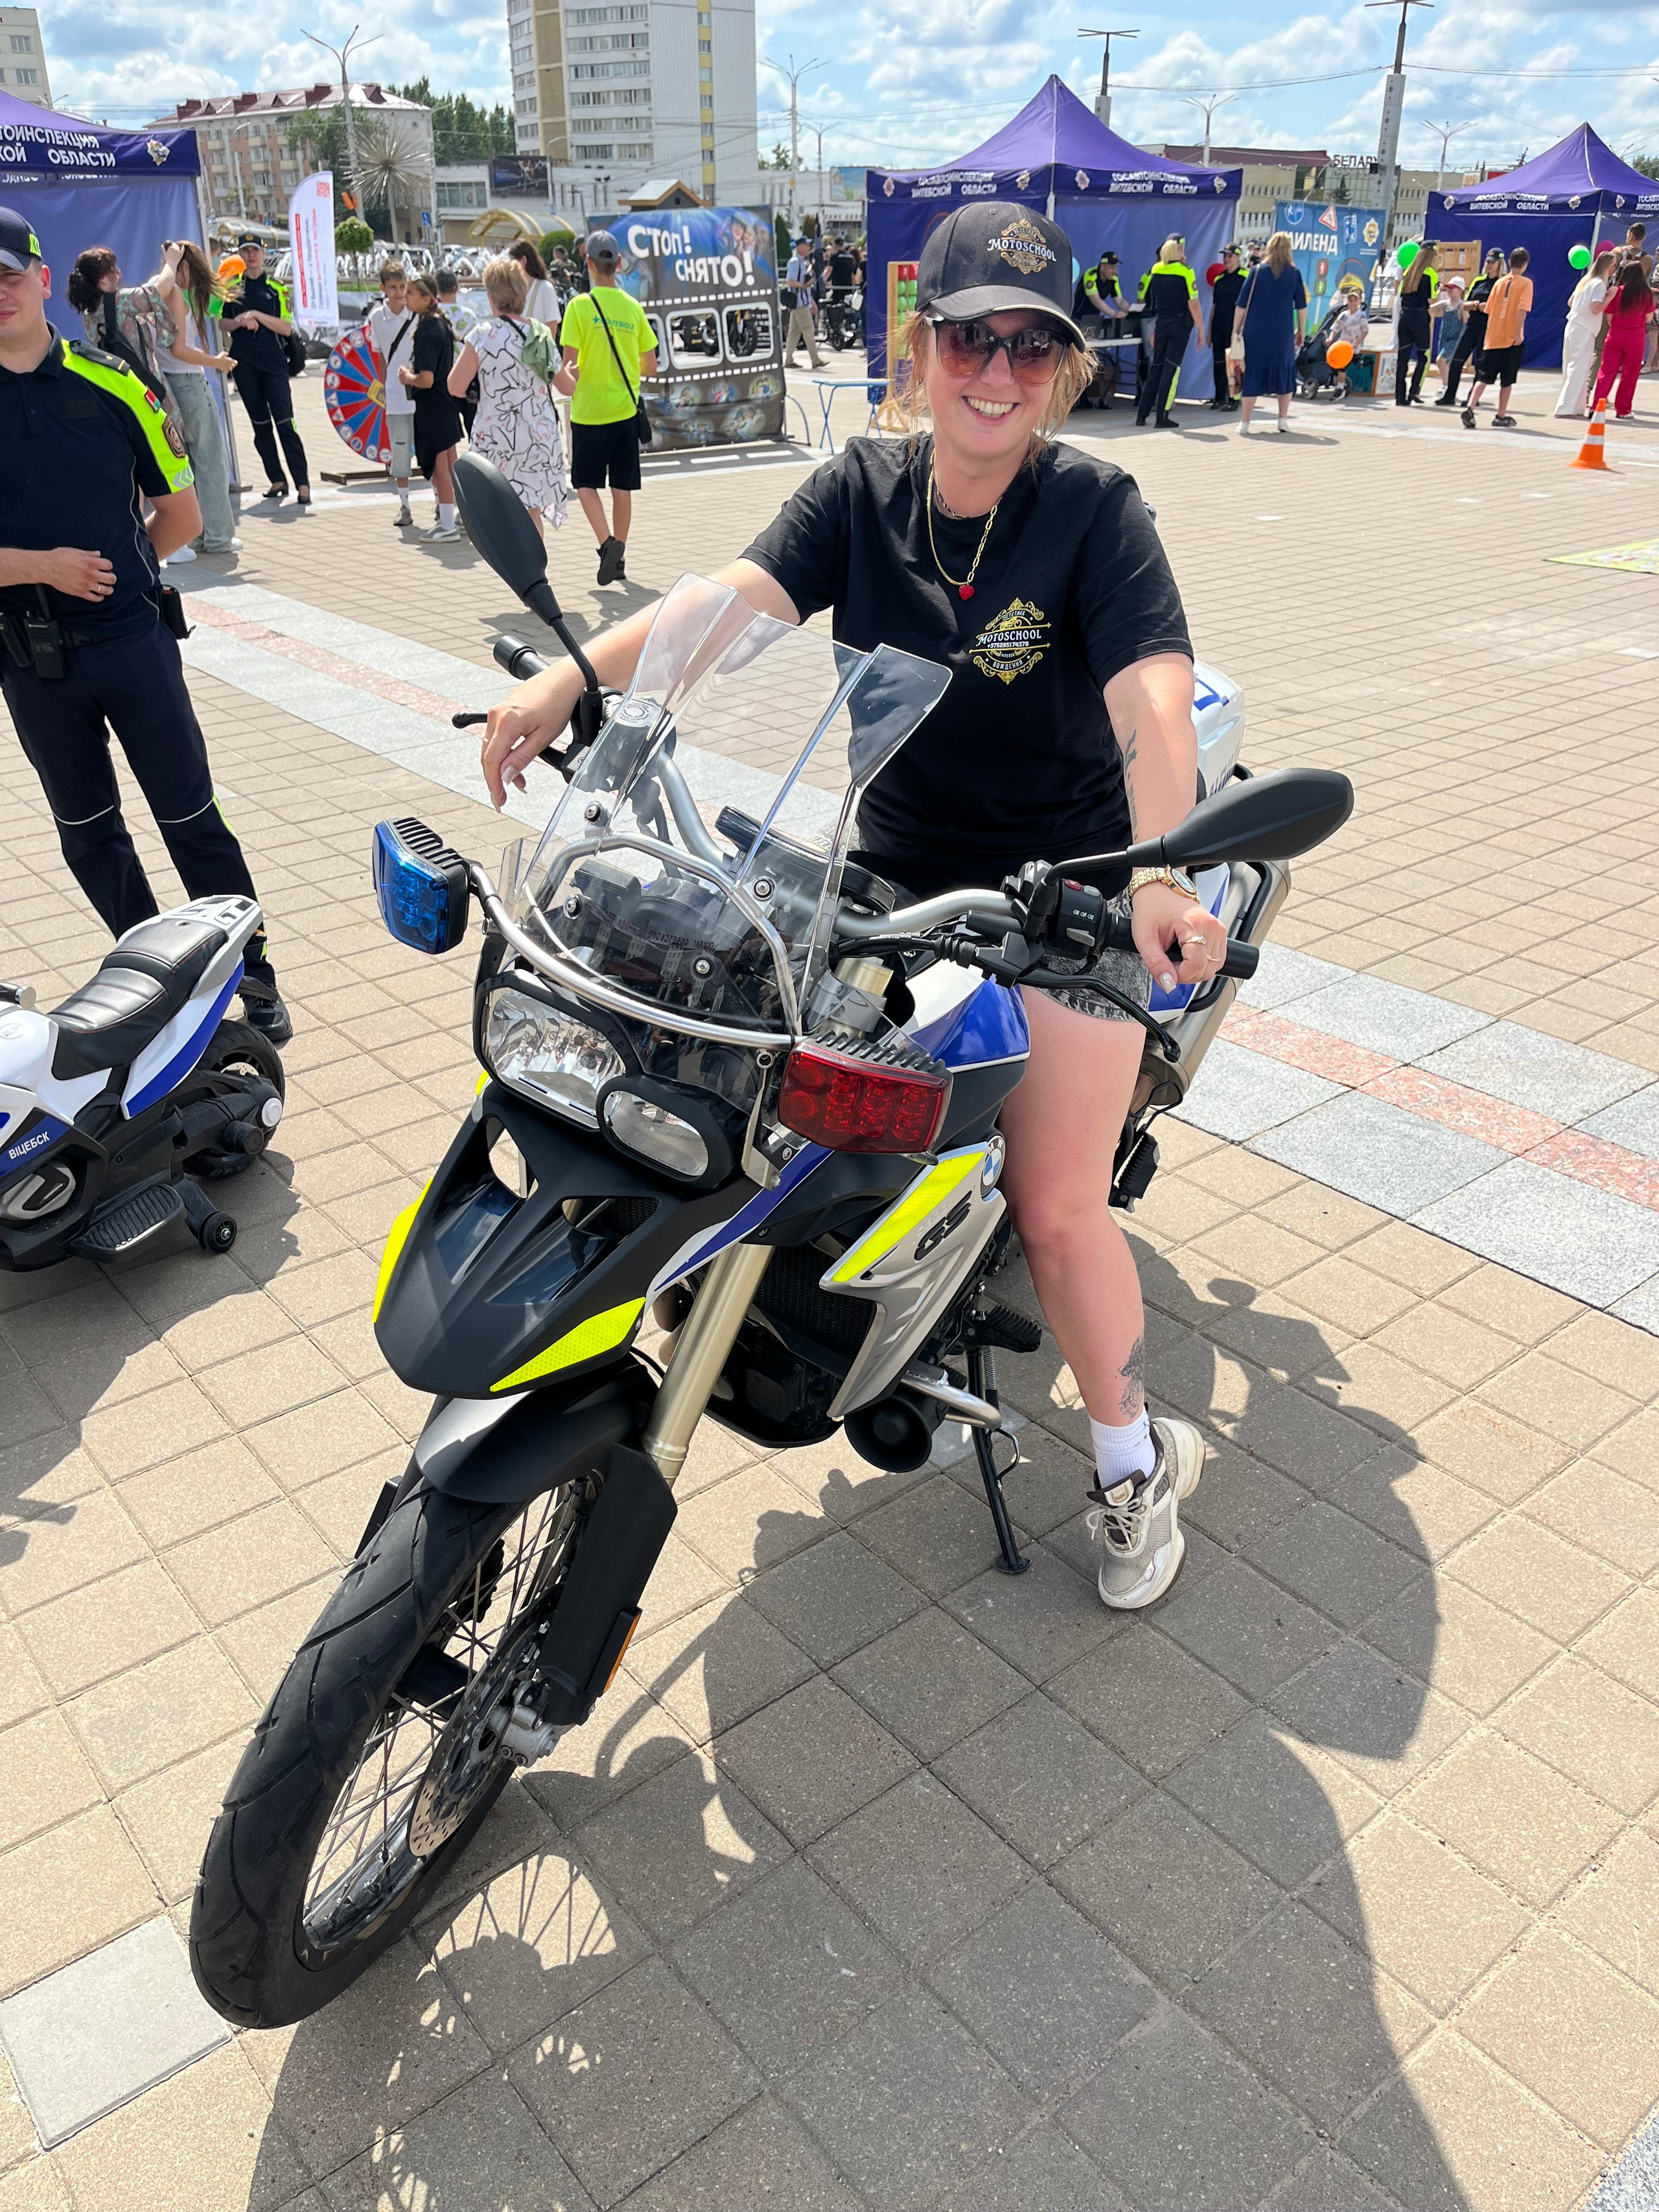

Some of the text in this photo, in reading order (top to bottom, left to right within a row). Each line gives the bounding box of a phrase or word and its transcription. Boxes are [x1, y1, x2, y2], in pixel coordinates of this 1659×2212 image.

[47, 148, 116, 167] ОБЛАСТИ
[1334, 154, 1378, 167] БЕЛАР
[1516, 202, 1549, 211] ОБЛАСТИ
[987, 238, 1057, 262] MOTOSCHOOL
[975, 629, 1042, 647] MOTOSCHOOL
[992, 659, 1023, 670] ВОЖДЕНИЯ
[8, 1131, 50, 1159] ВІЦЕБСК
[913, 1191, 972, 1261] GS
